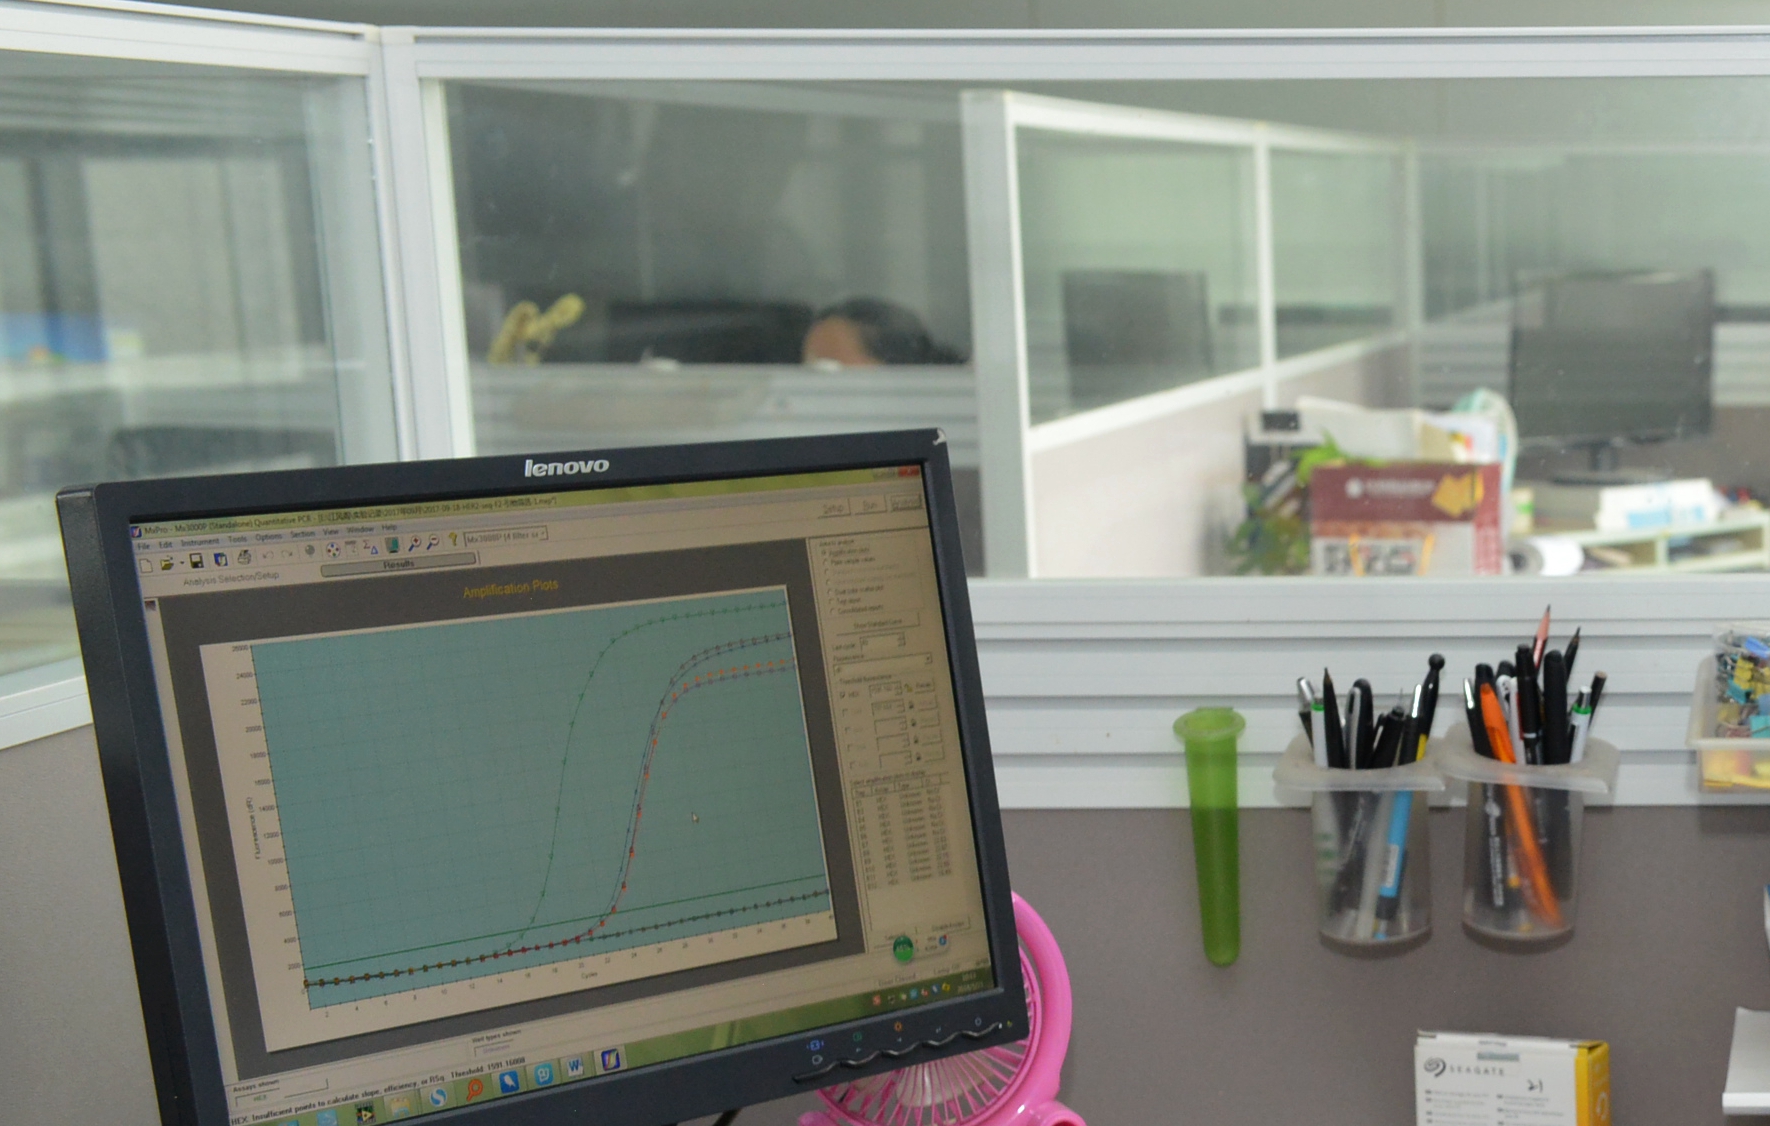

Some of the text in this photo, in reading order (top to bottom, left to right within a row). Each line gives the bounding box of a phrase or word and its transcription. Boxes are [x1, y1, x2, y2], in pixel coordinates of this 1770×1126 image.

[524, 459, 610, 478] lenovo
[383, 559, 415, 570] Results
[183, 571, 280, 587] Analysis Selection/Setup
[463, 578, 559, 599] Amplification Plots
[1450, 1064, 1505, 1077] SEAGATE
[252, 1107, 293, 1122] Insufficient
[327, 1091, 359, 1107] calculate
